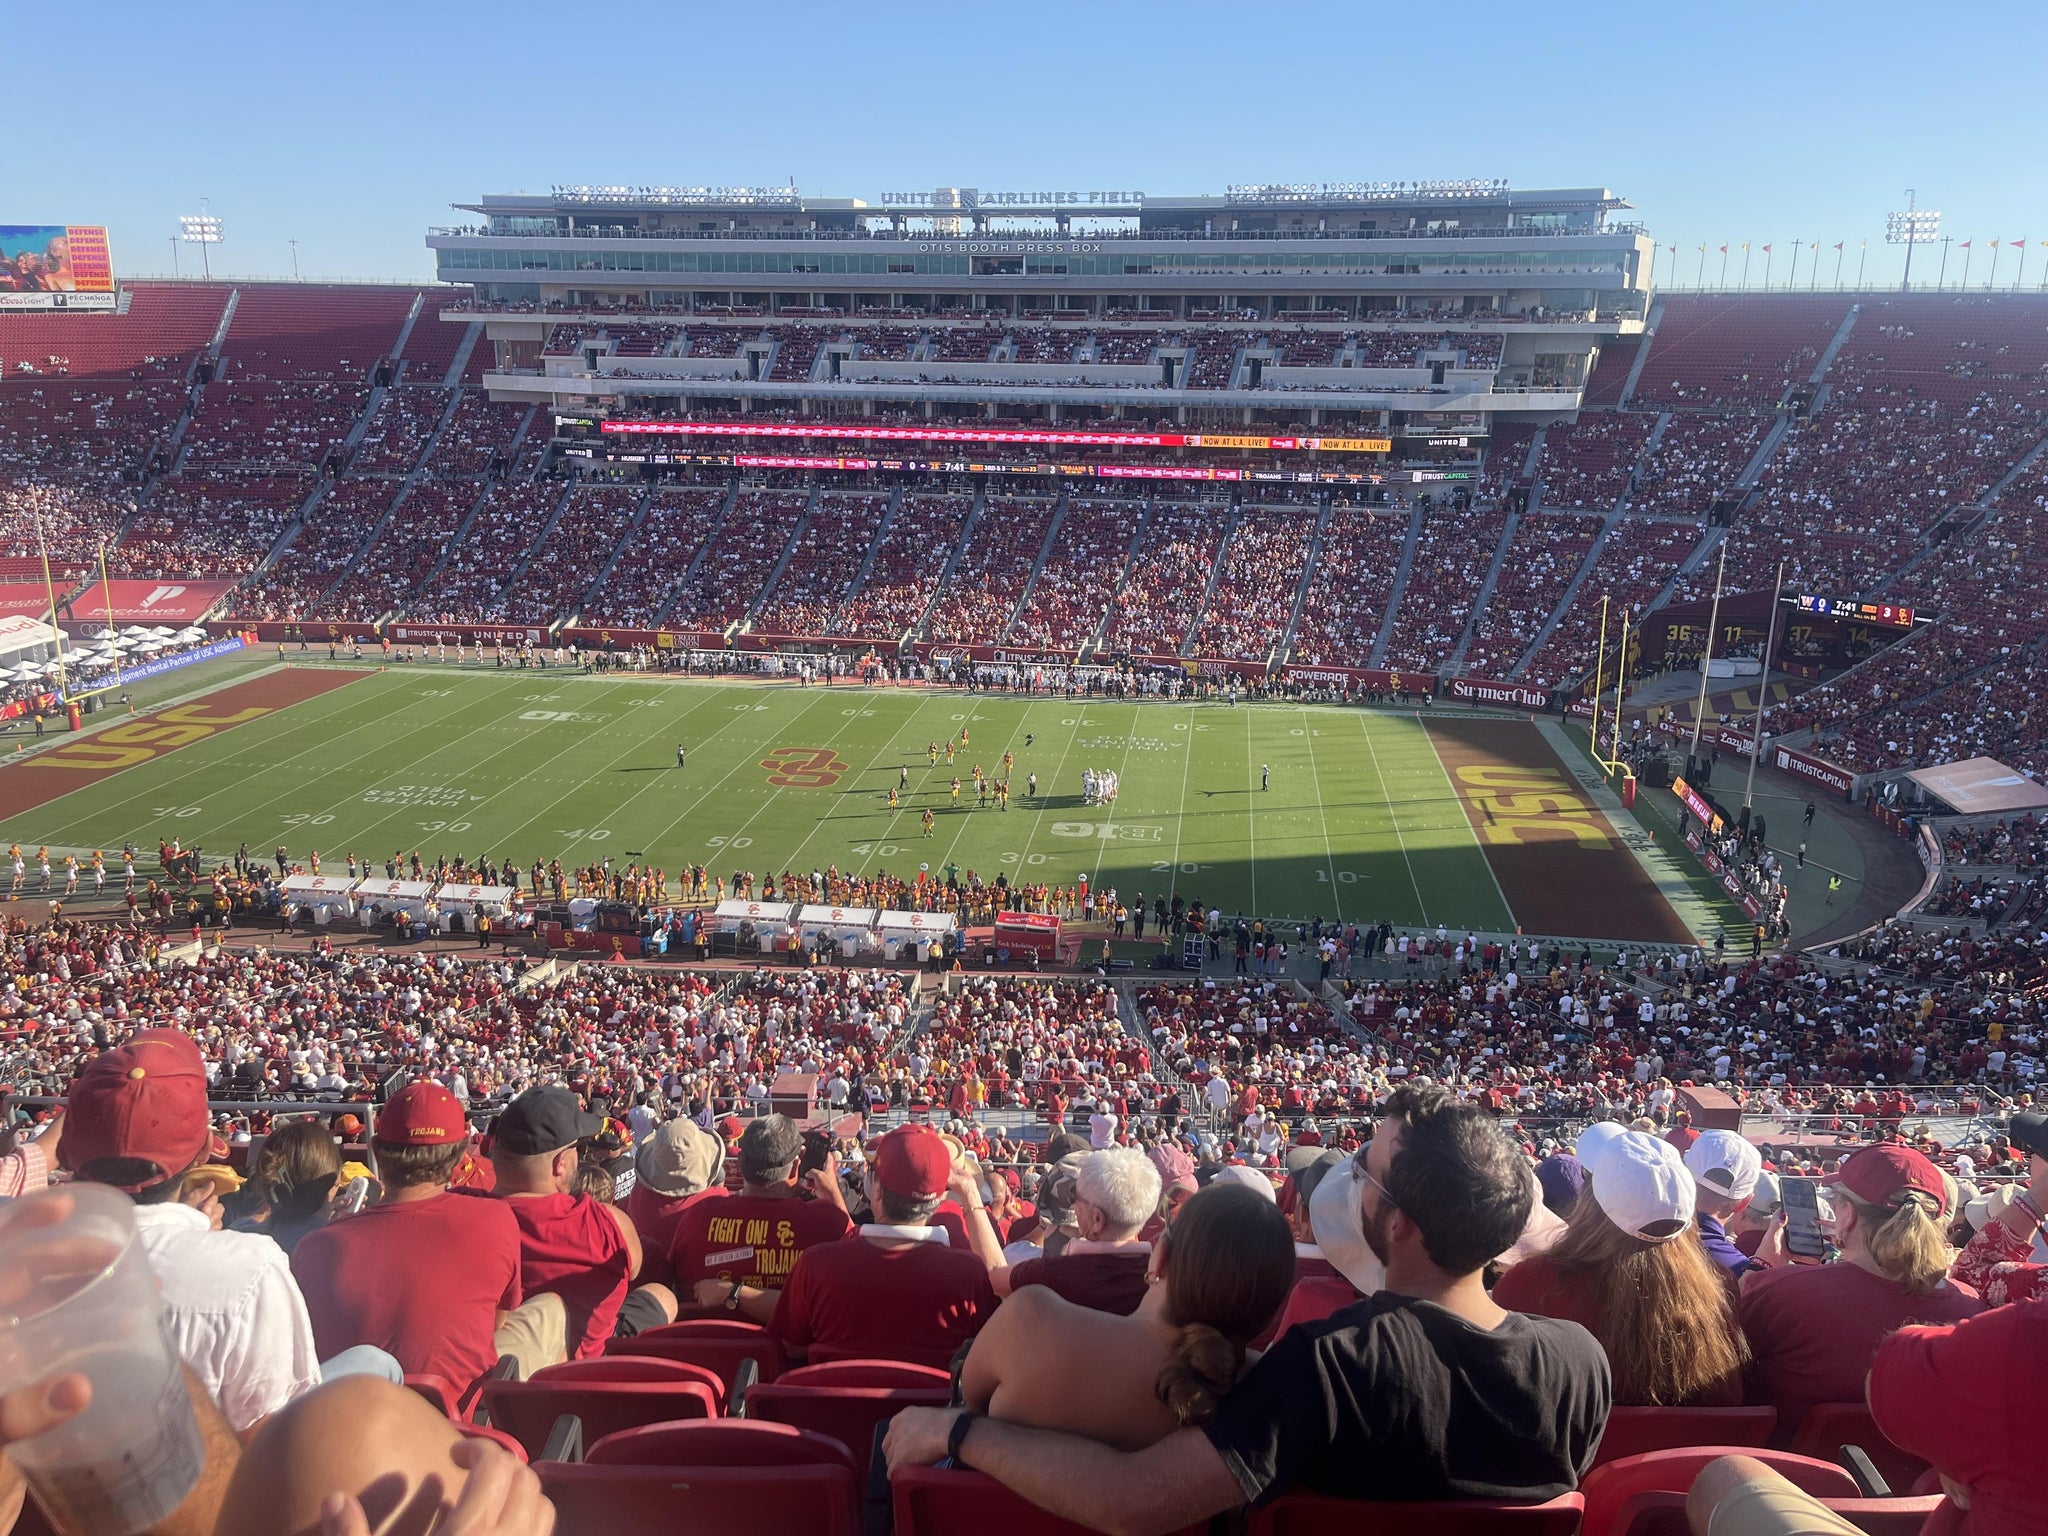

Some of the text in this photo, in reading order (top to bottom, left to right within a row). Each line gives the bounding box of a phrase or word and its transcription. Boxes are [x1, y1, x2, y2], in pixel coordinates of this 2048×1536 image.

[881, 191, 1146, 205] UNITED AIRLINES FIELD
[919, 243, 1102, 252] OTIS BOOTH PRESS BOX
[1248, 438, 1266, 446] LIVE!
[910, 462, 916, 470] 0
[945, 463, 964, 471] 7:41
[1801, 596, 1826, 608] W 0
[1836, 601, 1857, 611] 7:41
[1883, 608, 1891, 617] 3
[474, 631, 524, 640] UNITED
[1667, 624, 1692, 640] 36
[1724, 626, 1741, 642] 11
[109, 641, 240, 687] Equipment Rental Partner of USC Athletics
[1199, 668, 1226, 676] UNION
[1289, 670, 1349, 682] POWERADE
[1390, 674, 1400, 690] SC
[1454, 680, 1546, 706] SummerClub
[20, 704, 272, 769] USC
[1720, 732, 1742, 752] Lazy
[1789, 760, 1846, 791] ITRUSTCAPITAL
[156, 807, 202, 818] 10
[1456, 765, 1616, 850] USC
[282, 814, 336, 826] 20
[422, 820, 472, 833] 30
[563, 828, 612, 840] 40
[705, 836, 754, 849] 50
[851, 843, 900, 856] 40
[1000, 851, 1047, 865] 30
[1151, 861, 1199, 874] 20
[1316, 869, 1358, 884] 10
[1528, 936, 1674, 954] ITRUSTCAPITA
[410, 1127, 445, 1136] TROJANS
[616, 1168, 636, 1184] APEX
[707, 1217, 769, 1245] FIGHT ON!
[776, 1221, 794, 1247] SC
[755, 1249, 803, 1274] TROJAN
